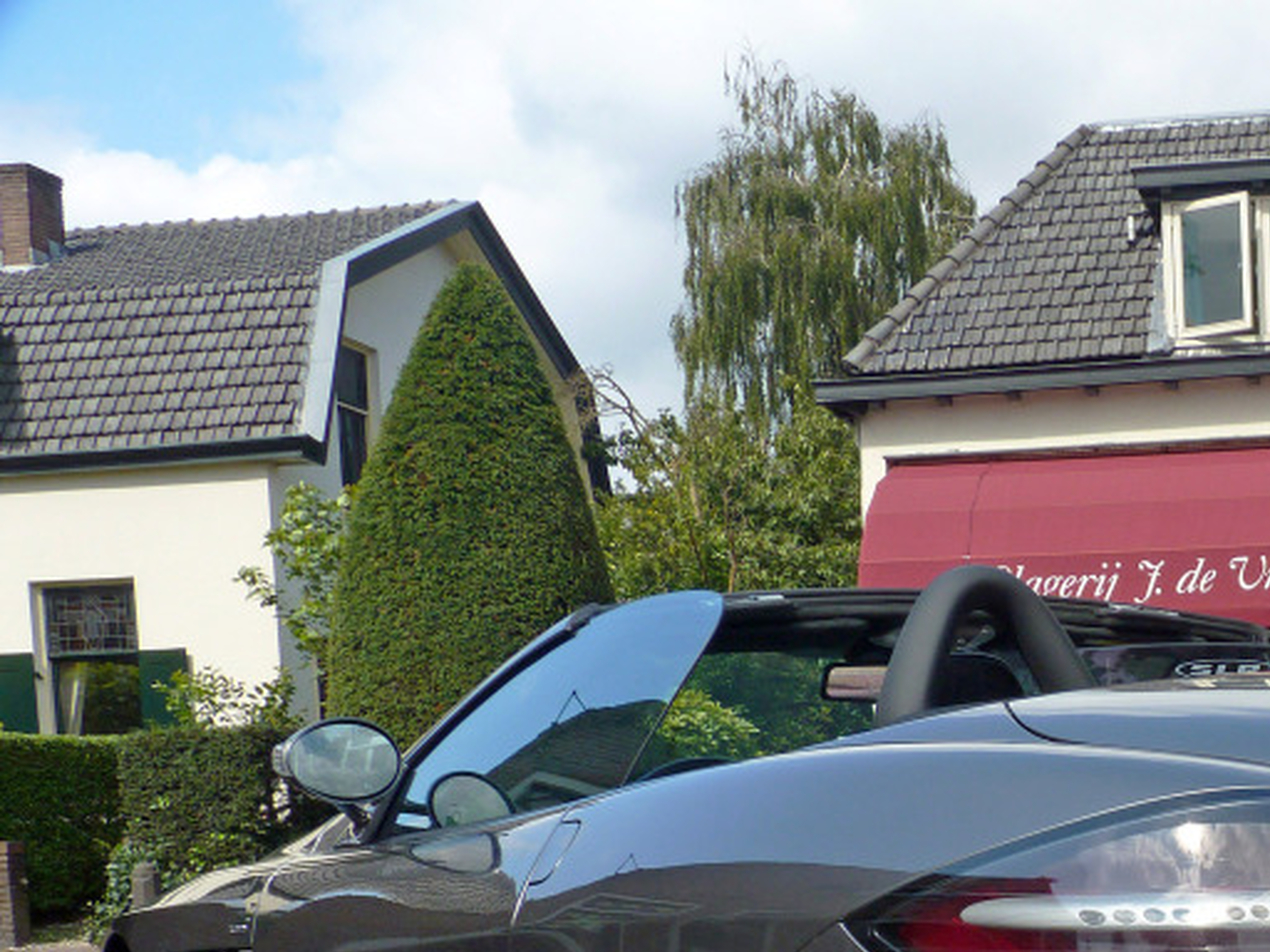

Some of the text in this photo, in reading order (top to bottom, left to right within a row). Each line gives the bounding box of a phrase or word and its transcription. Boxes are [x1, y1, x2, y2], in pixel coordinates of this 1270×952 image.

[997, 561, 1121, 602] agerij
[1133, 560, 1165, 603] J.
[1176, 557, 1218, 594] de
